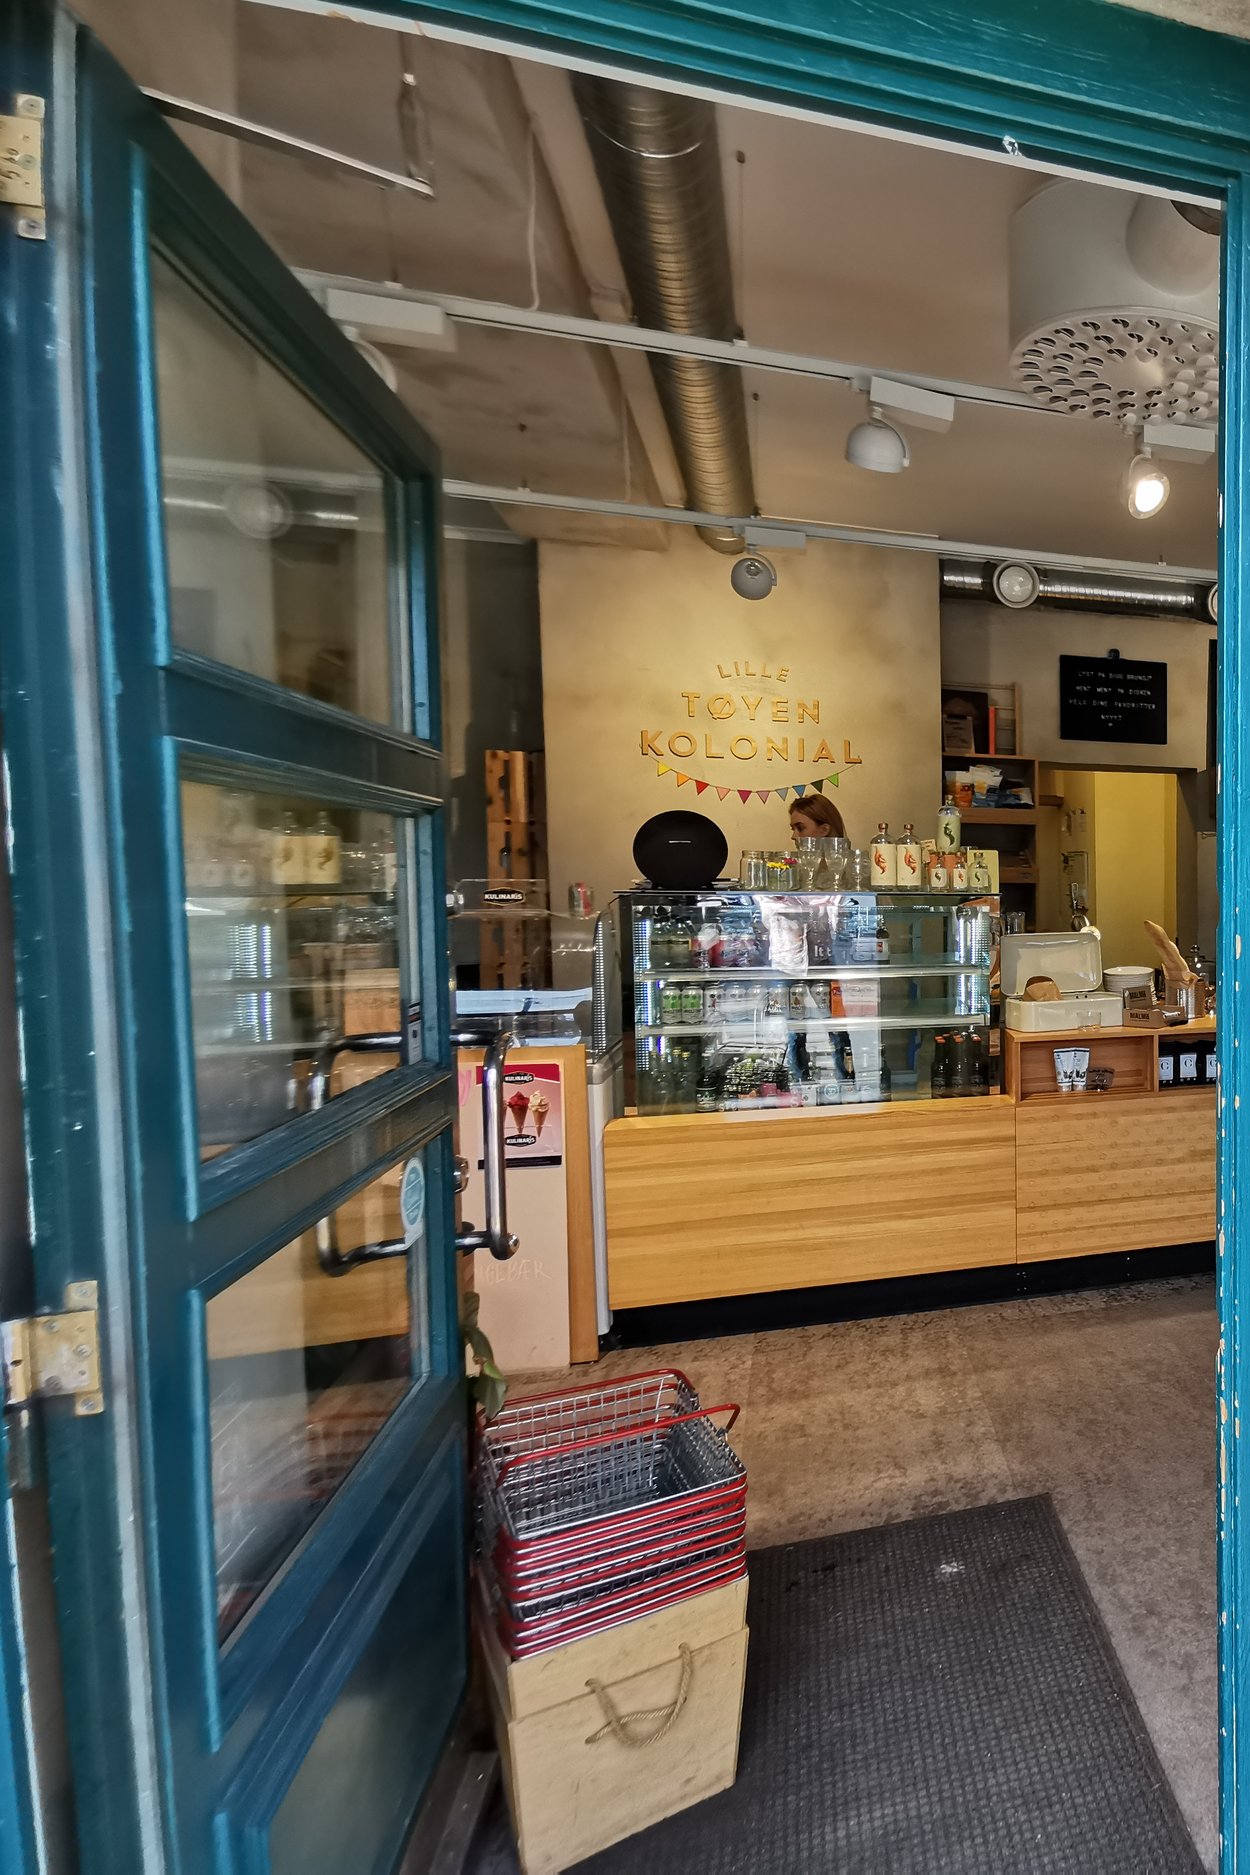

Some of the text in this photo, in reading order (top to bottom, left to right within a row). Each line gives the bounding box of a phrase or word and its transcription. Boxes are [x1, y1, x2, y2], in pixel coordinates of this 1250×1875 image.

[717, 661, 789, 683] LILLE
[681, 691, 820, 724] TØYEN
[640, 729, 862, 764] KOLONIAL
